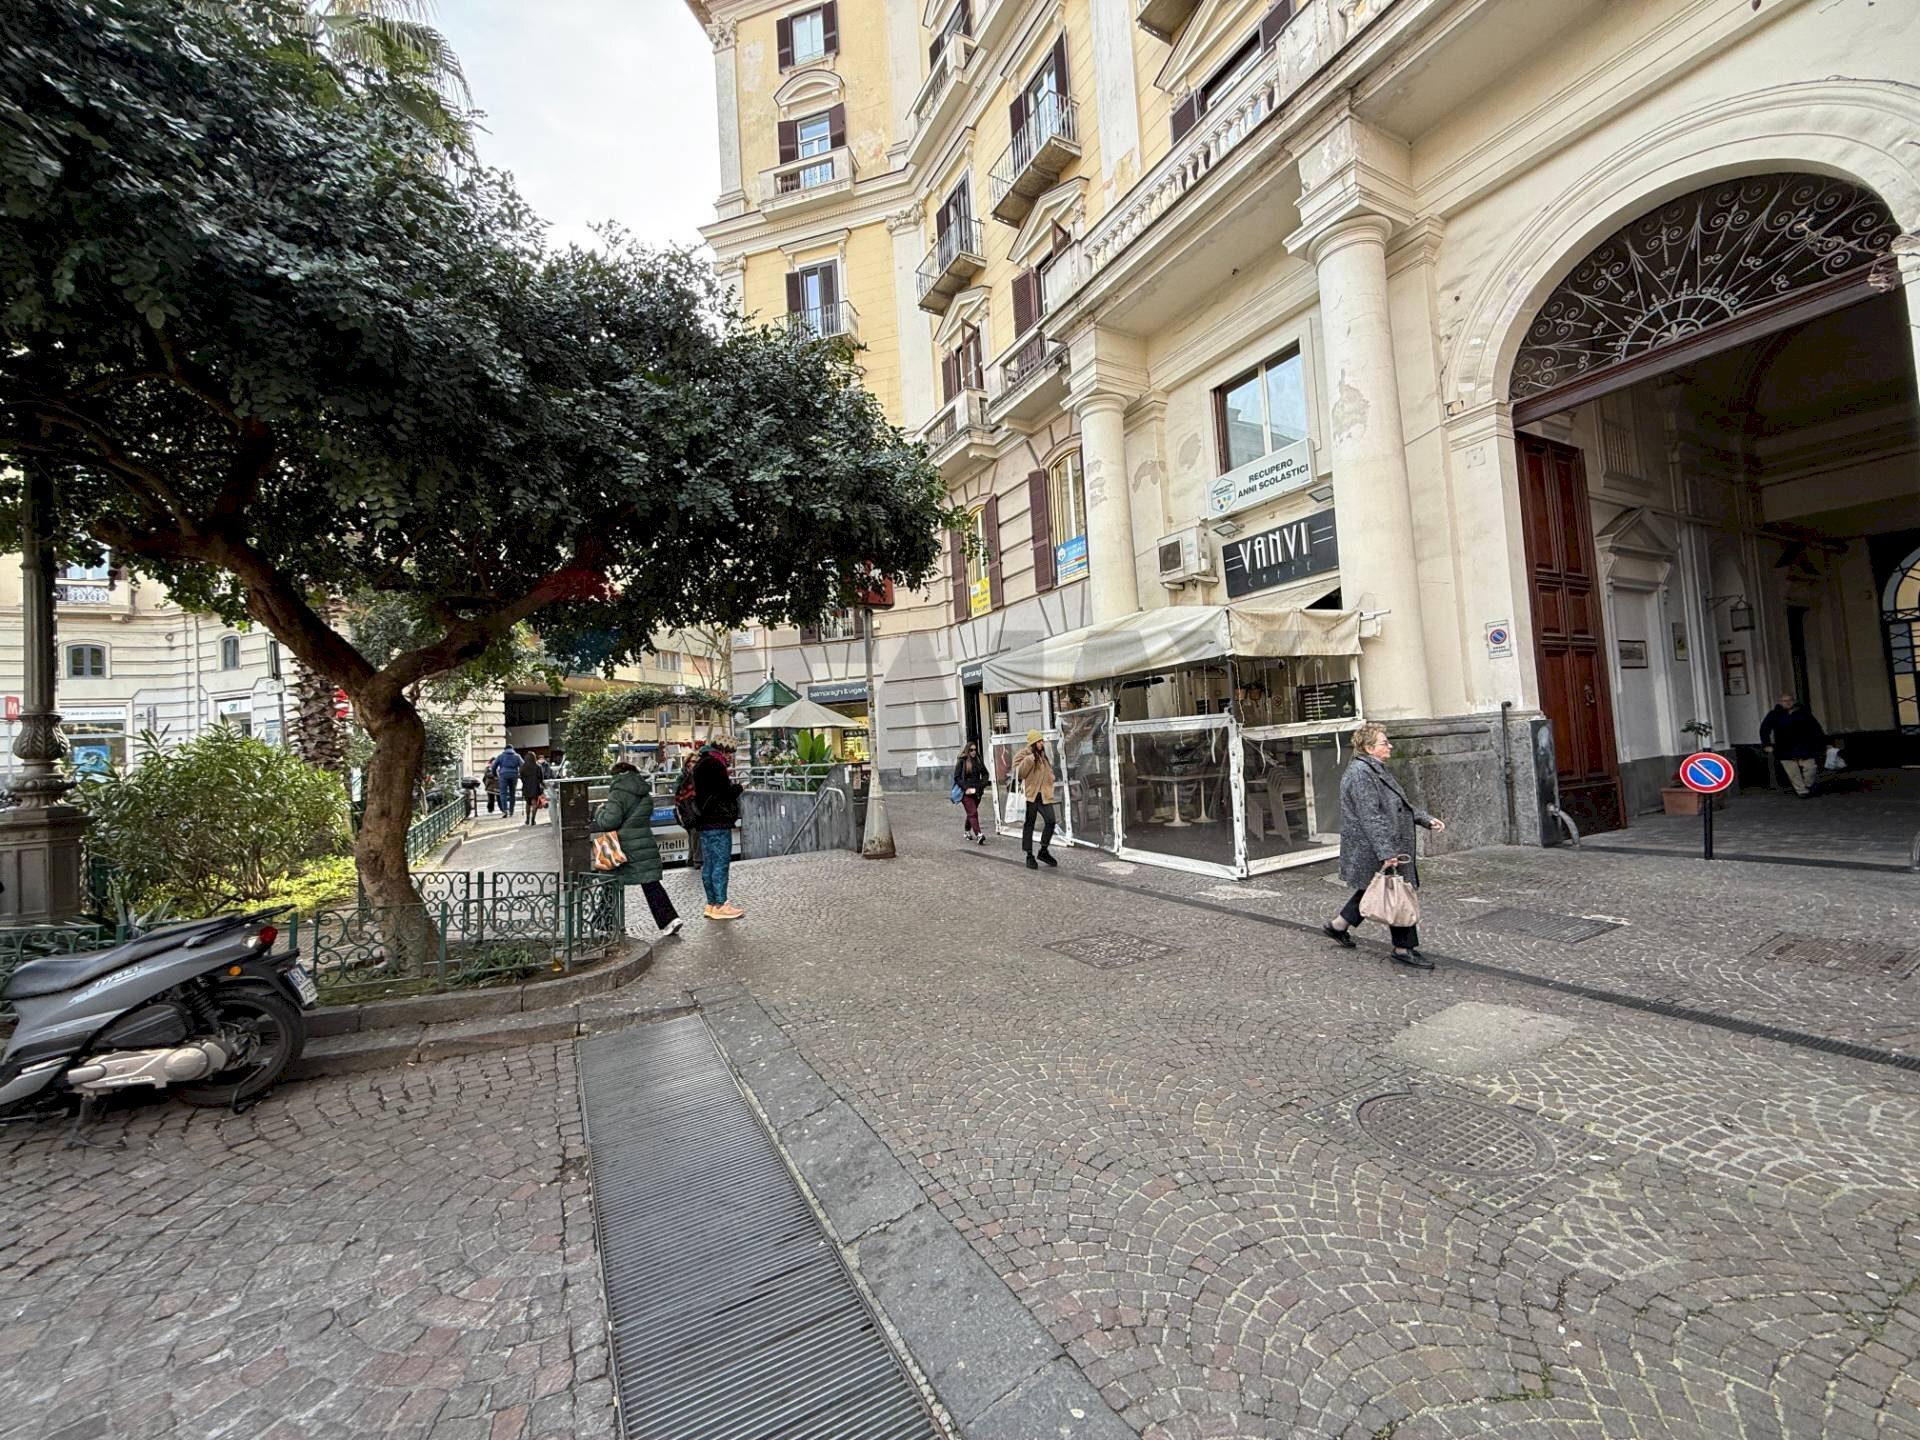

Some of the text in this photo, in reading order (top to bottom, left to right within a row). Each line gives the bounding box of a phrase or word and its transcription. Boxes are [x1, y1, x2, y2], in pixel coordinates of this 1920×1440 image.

[1237, 483, 1258, 499] ANNI
[1258, 463, 1309, 490] SCOLASTICI
[1248, 458, 1293, 483] RECUPERO
[1238, 522, 1310, 573] VANVI
[8, 702, 18, 716] M
[656, 839, 685, 850] vitelli
